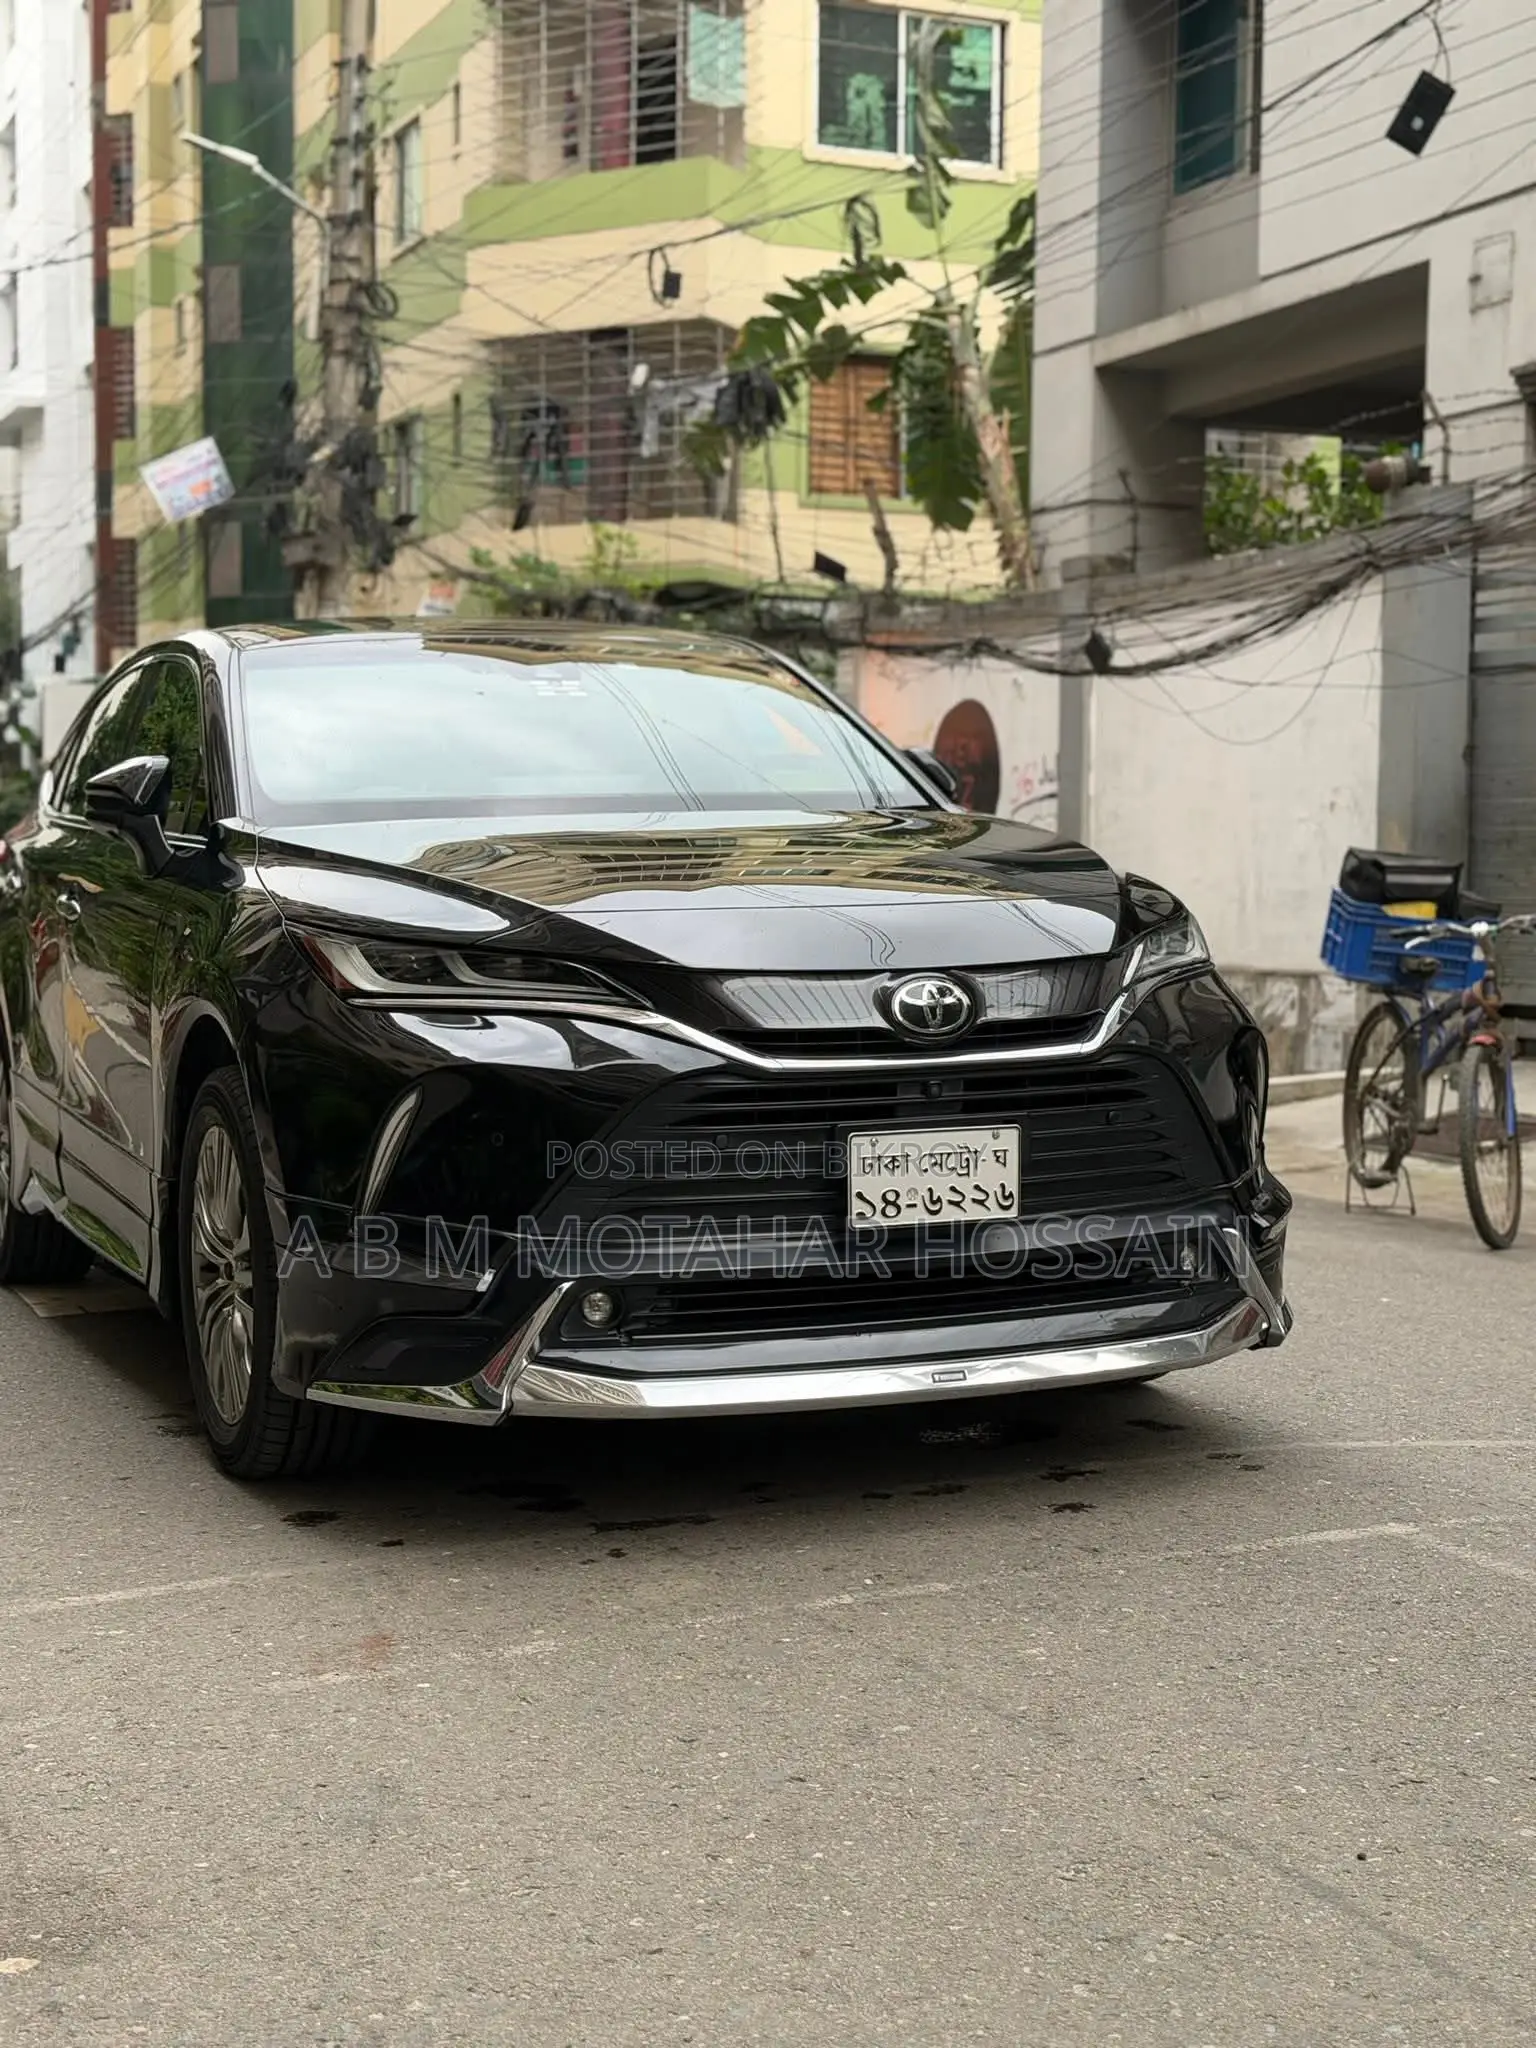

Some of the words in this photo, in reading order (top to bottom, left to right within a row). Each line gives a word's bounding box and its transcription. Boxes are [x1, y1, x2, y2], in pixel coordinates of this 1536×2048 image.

[860, 1152, 911, 1176] ঢাকা
[992, 1148, 1009, 1168] ঘ
[855, 1182, 1015, 1219] ১৪-৬২২৬
